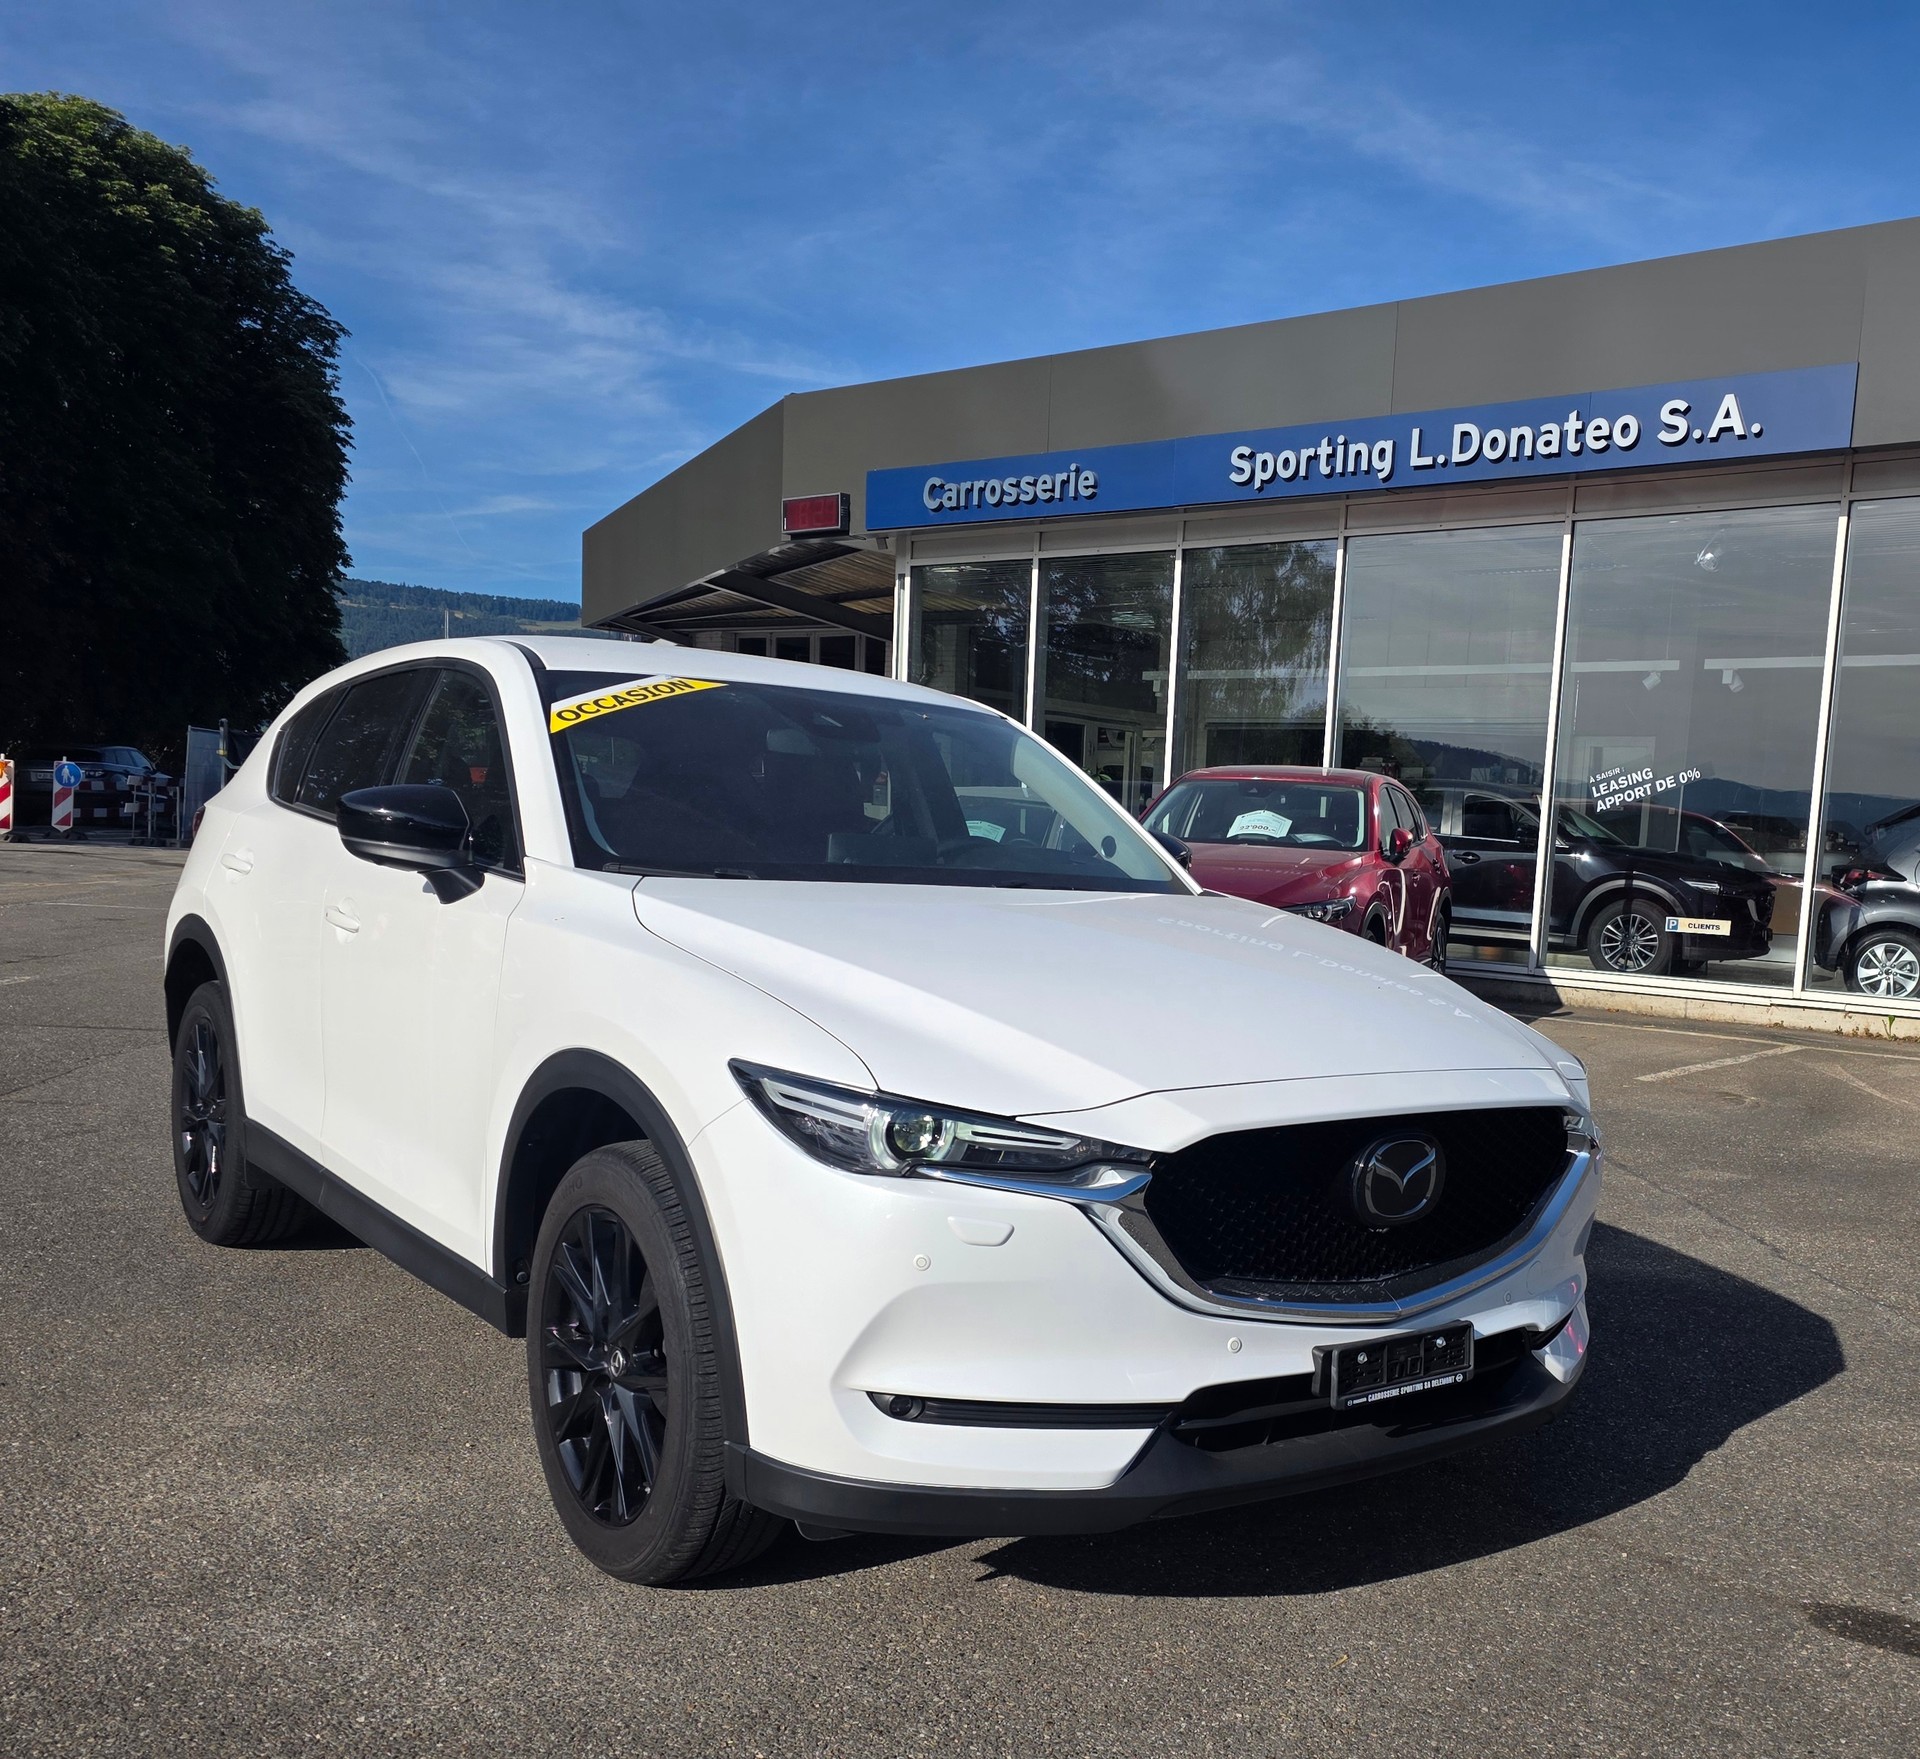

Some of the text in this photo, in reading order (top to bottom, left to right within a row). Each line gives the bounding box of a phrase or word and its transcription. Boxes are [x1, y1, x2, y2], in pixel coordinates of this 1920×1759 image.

[1228, 393, 1762, 491] Sporting L.Donateo S.A.
[923, 463, 1098, 512] Carrosserie
[556, 680, 695, 722] OCCASION
[1591, 767, 1653, 798] LEASING
[1596, 767, 1621, 782] SAISIR
[1596, 767, 1701, 813] APPORT DE 0%
[1687, 922, 1721, 931] CLIENTS
